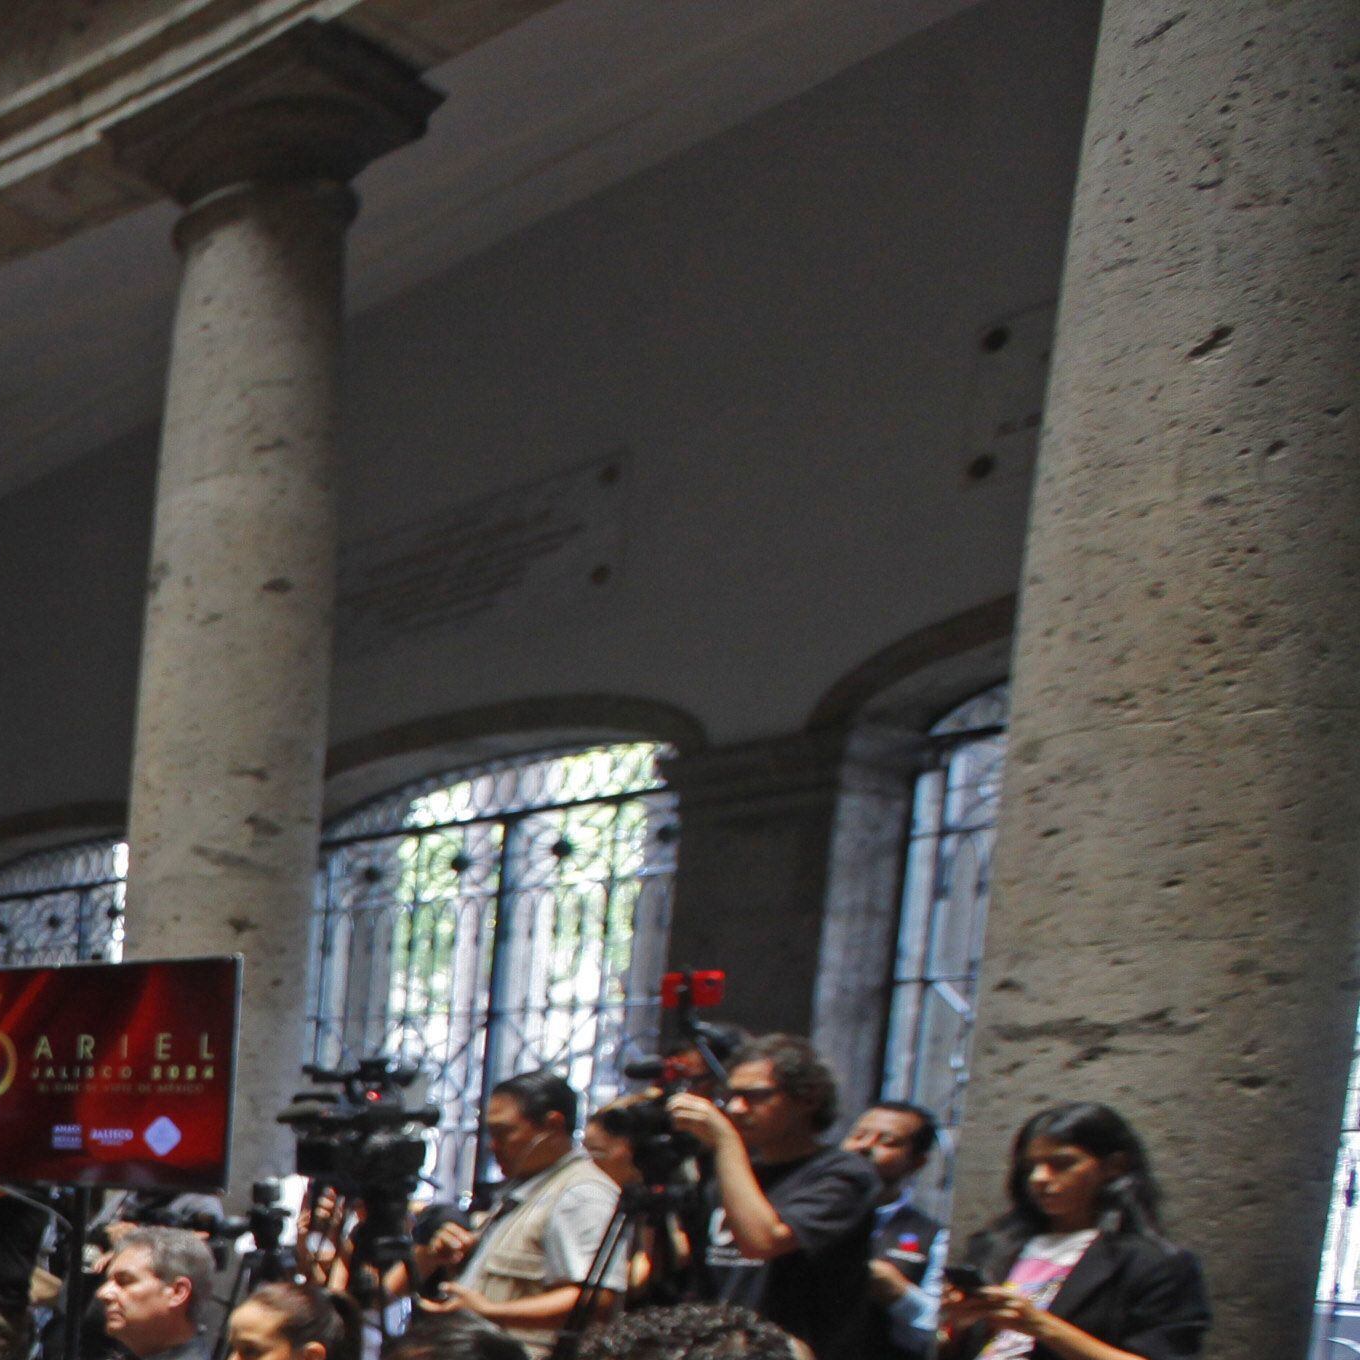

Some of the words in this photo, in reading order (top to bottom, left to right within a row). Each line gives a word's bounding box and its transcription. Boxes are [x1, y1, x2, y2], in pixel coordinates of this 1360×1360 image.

[33, 1032, 215, 1061] ARIEL
[31, 1064, 133, 1080] JALISCO
[150, 1063, 216, 1081] 2024
